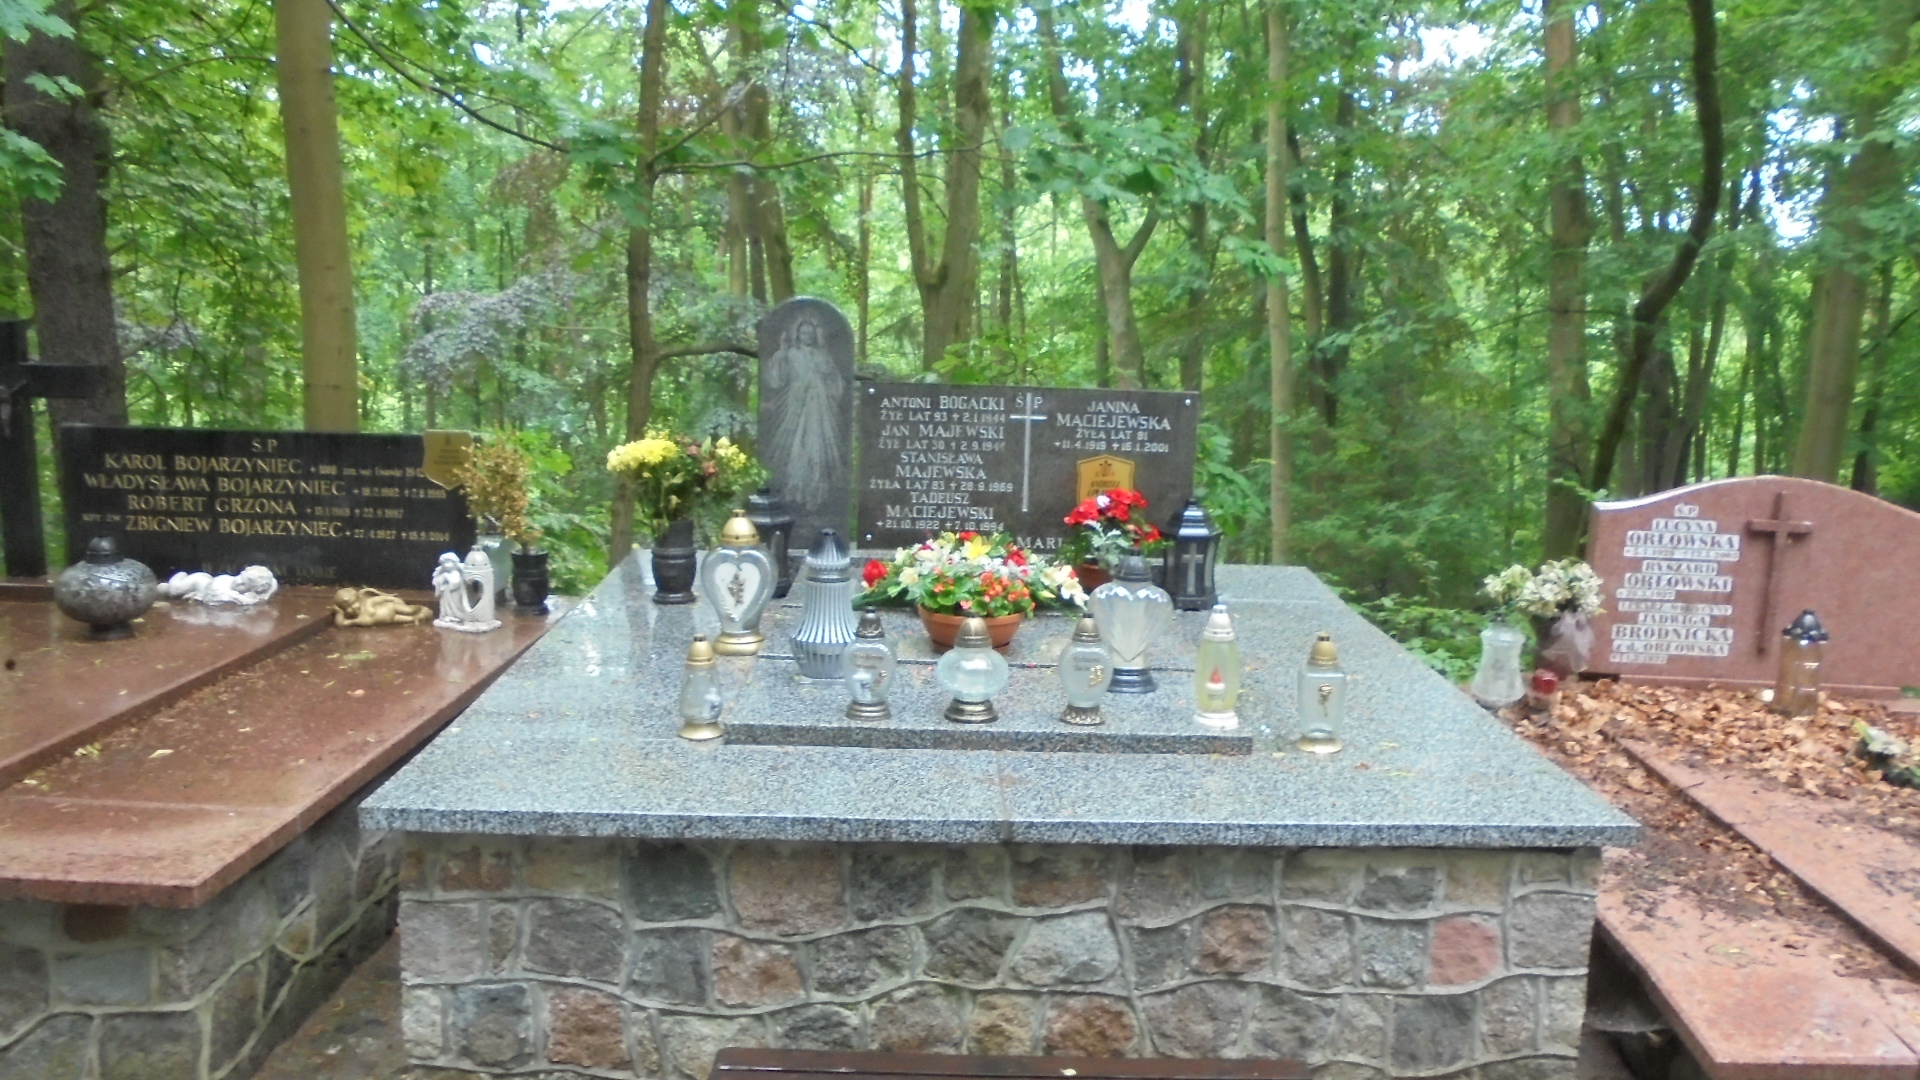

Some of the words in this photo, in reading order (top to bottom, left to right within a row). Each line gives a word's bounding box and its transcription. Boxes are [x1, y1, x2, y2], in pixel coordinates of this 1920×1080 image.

[880, 396, 931, 409] ANTONI
[939, 395, 1005, 411] BOGACKI
[1087, 401, 1140, 414] JANINA
[909, 411, 931, 421] LAT
[934, 411, 948, 421] 93
[1056, 413, 1172, 430] MACIEJEWSKA
[882, 424, 910, 437] JAN
[918, 424, 1005, 439] MAJEWSKI
[1075, 428, 1106, 439] ŻYŁA
[1111, 430, 1132, 440] LAT
[1137, 431, 1149, 441] 81
[906, 440, 929, 449] LAT
[104, 453, 167, 470] KAROL
[174, 454, 302, 474] BOJARZYNIEC
[901, 451, 983, 465] STANISŁAWA
[895, 465, 988, 479] MAJEWSKA
[83, 472, 210, 492] WŁADYSŁAWA
[217, 477, 345, 496] BOJARZYNIEC
[869, 476, 901, 489] ŻYŁA
[906, 480, 929, 490] LAT
[931, 481, 945, 490] 83
[910, 491, 970, 504] TADEUSZ
[128, 495, 207, 512] ROBERT
[215, 498, 298, 515] GRZONA
[886, 505, 994, 520] MACIEJEWSKI
[126, 515, 212, 532] ZBIGNIEW
[219, 518, 343, 537] BOJARZYNIEC
[1654, 519, 1714, 533] LUCYNA
[1628, 532, 1736, 549] ORŁOWSKA
[1644, 561, 1717, 574] RYSZARD
[1626, 575, 1730, 591] ORŁOWSKI
[1642, 614, 1708, 625] JADWIGA
[1615, 627, 1731, 641] BRODNICKA
